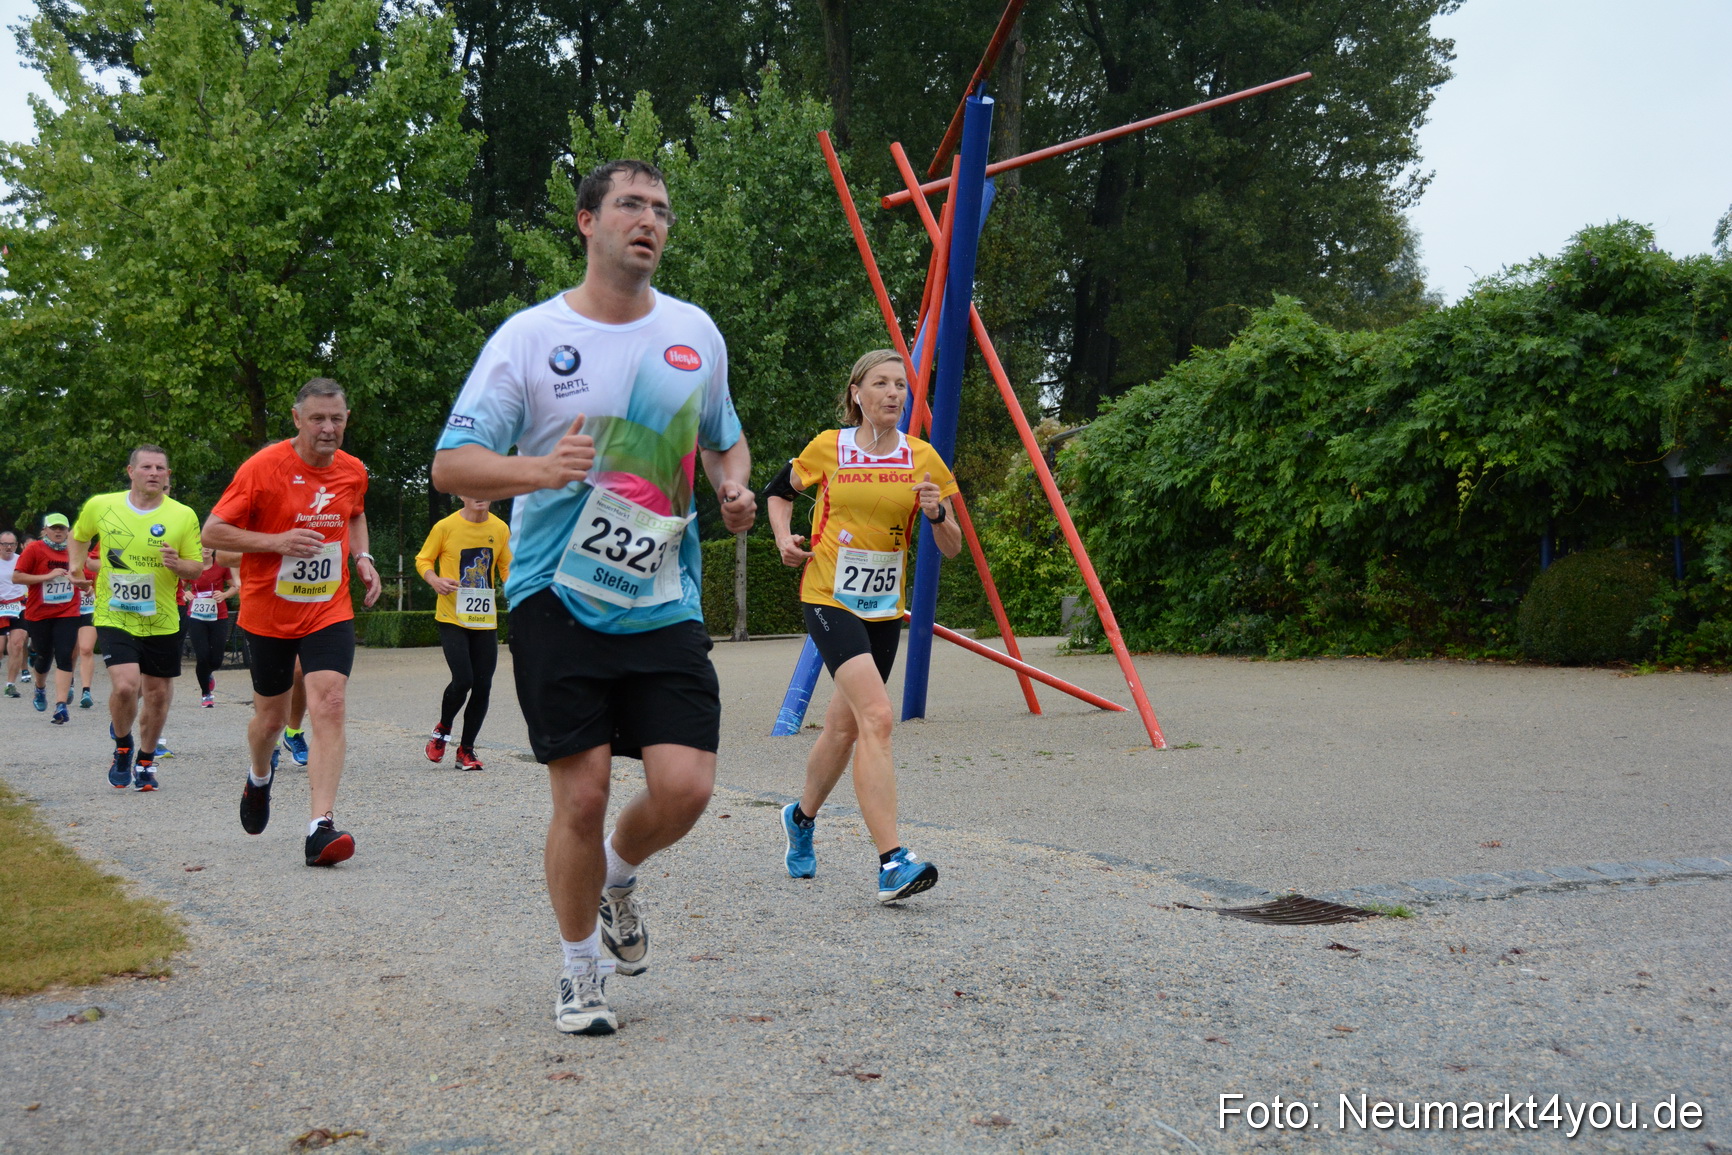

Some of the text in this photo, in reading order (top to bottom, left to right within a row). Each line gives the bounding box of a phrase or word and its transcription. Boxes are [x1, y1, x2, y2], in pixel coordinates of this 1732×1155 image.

[553, 378, 588, 393] PARTL
[555, 386, 591, 399] Neumarkt
[838, 471, 916, 483] MAX BÖGL
[596, 500, 630, 520] NeuerMarkt
[581, 517, 667, 574] 2323
[293, 558, 331, 581] 330
[593, 567, 639, 596] Stefan
[843, 565, 896, 593] 2755
[46, 582, 72, 594] 2774
[113, 582, 151, 600] 2890
[293, 585, 327, 595] Manfred
[120, 603, 142, 611] Rainer
[194, 603, 216, 612] 2374
[466, 597, 490, 613] 226
[857, 599, 878, 610] Petra
